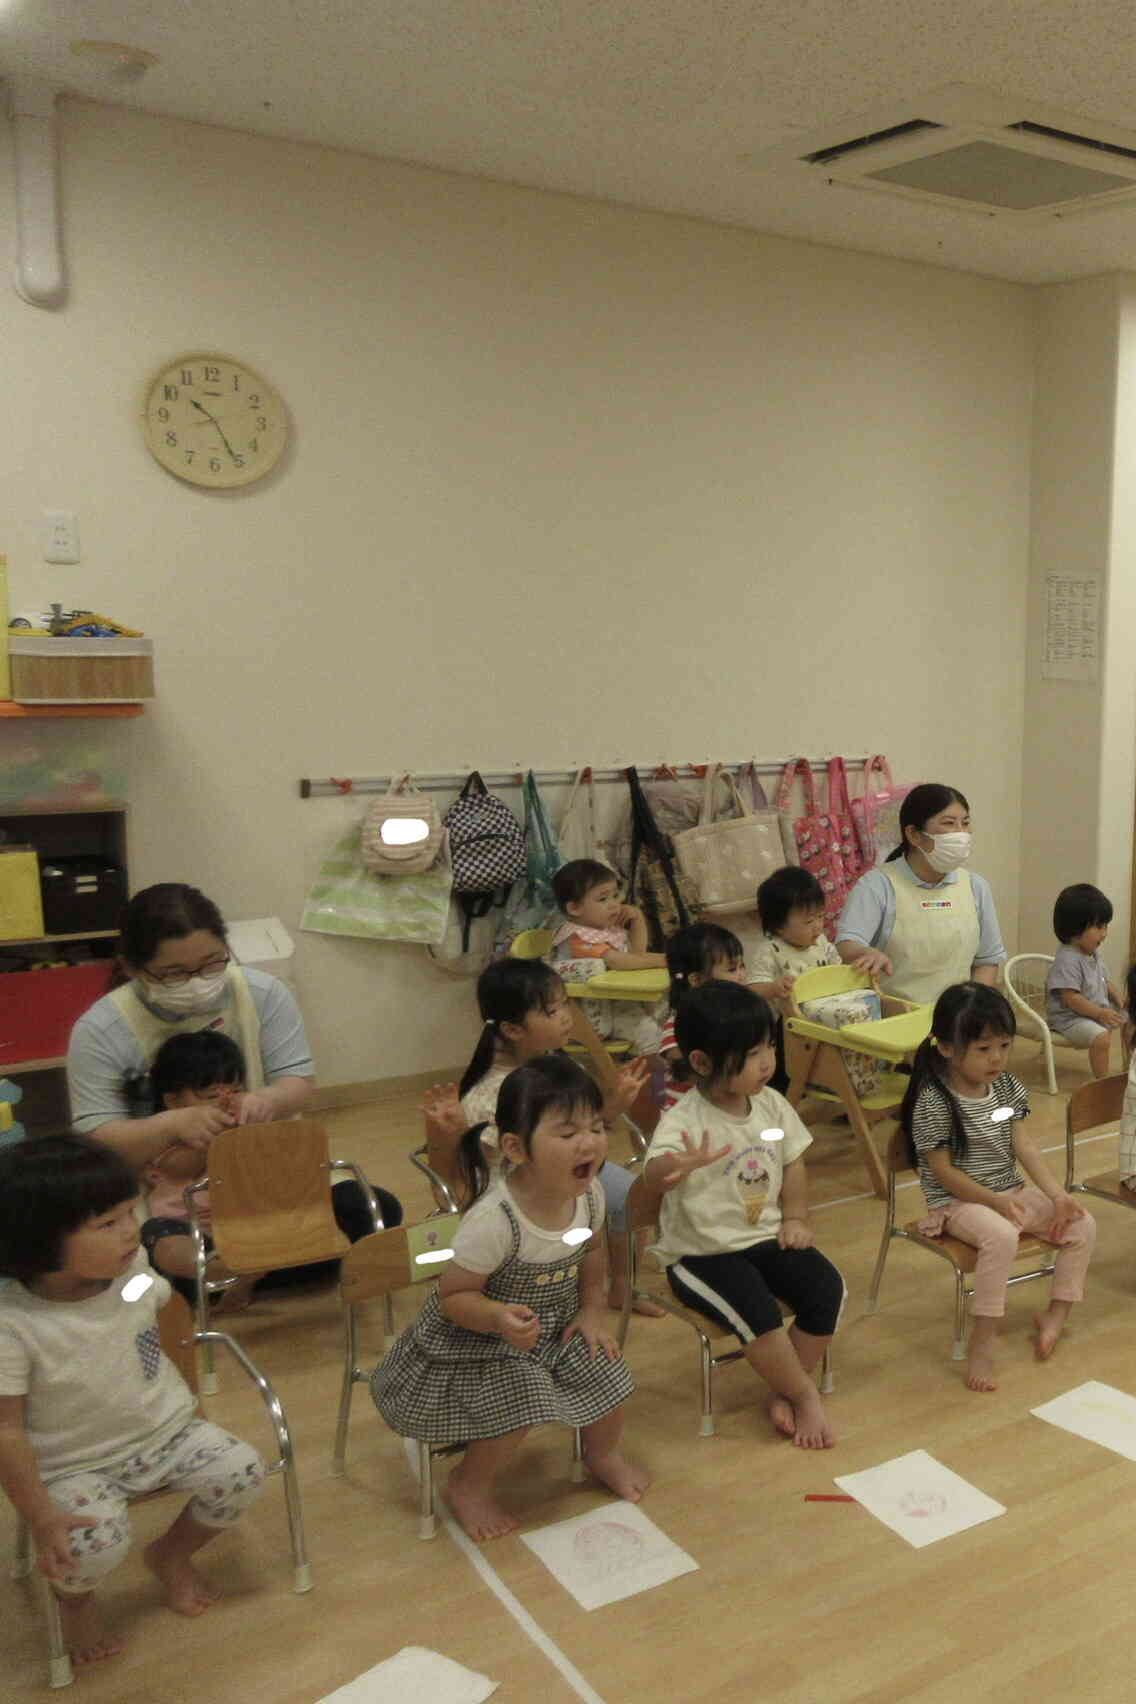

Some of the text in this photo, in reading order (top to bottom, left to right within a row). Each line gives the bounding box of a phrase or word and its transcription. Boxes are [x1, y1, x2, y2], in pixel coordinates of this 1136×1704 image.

[181, 370, 193, 386] 11
[204, 367, 220, 383] 12
[233, 375, 240, 391] 1
[164, 384, 178, 401] 10
[249, 394, 260, 410] 2
[158, 407, 170, 423] 9
[256, 416, 267, 432] 3
[166, 432, 177, 447] 8
[248, 438, 257, 452] 4
[185, 450, 195, 464] 7
[210, 458, 221, 472] 6
[233, 454, 246, 469] 5
